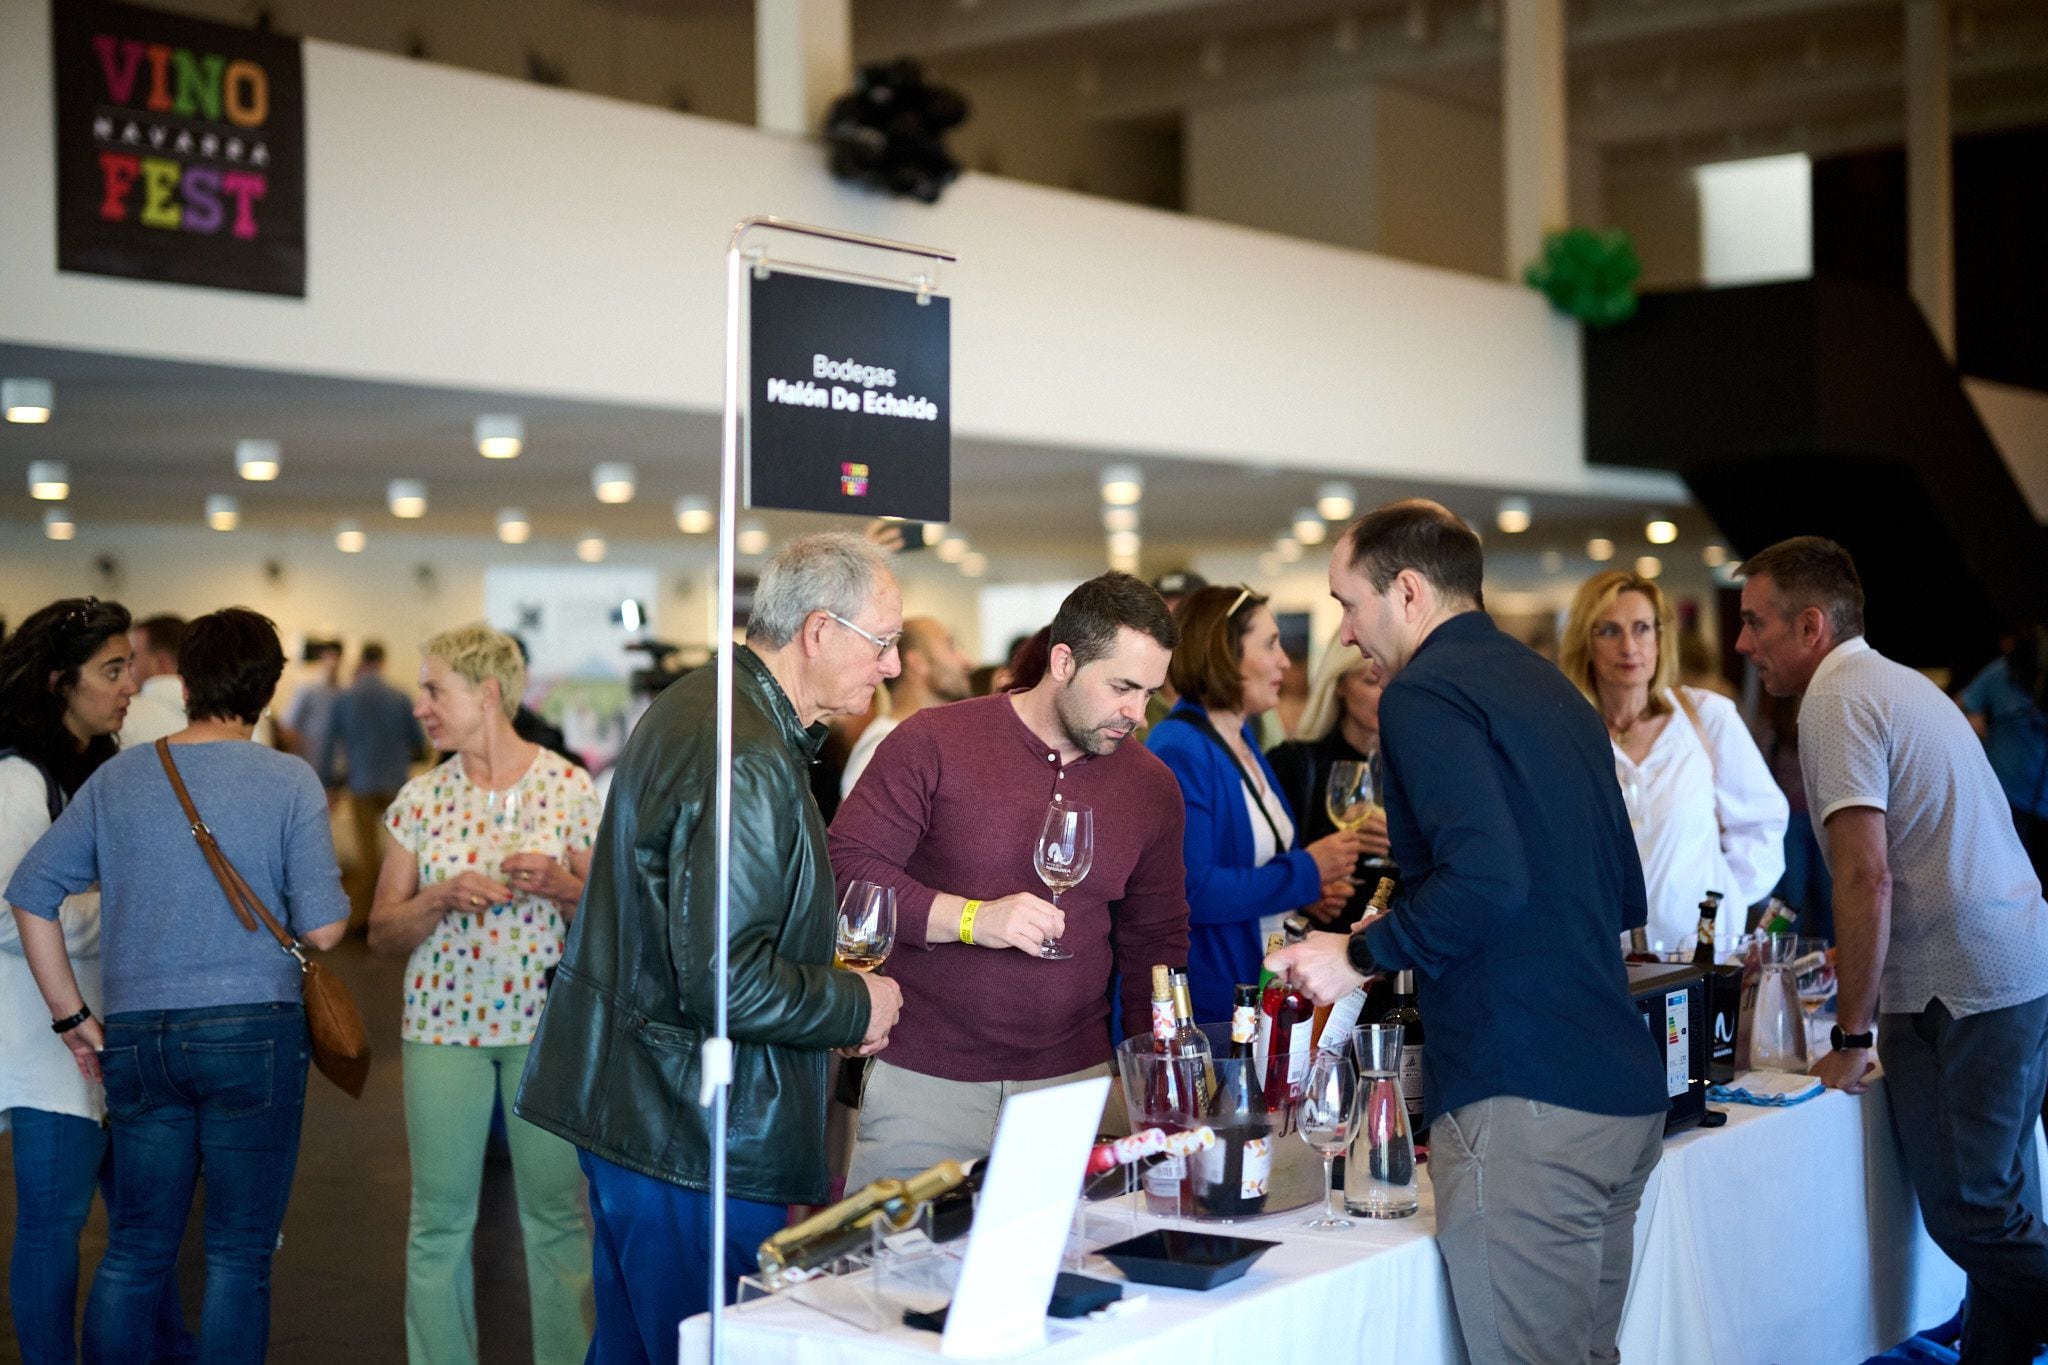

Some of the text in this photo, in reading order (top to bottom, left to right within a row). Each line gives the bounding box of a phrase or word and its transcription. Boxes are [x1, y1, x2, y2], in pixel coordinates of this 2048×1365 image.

[92, 35, 270, 128] VINO
[99, 152, 268, 240] FEST
[813, 353, 897, 389] Bodegas
[831, 386, 860, 413] De
[863, 390, 939, 421] Echaide
